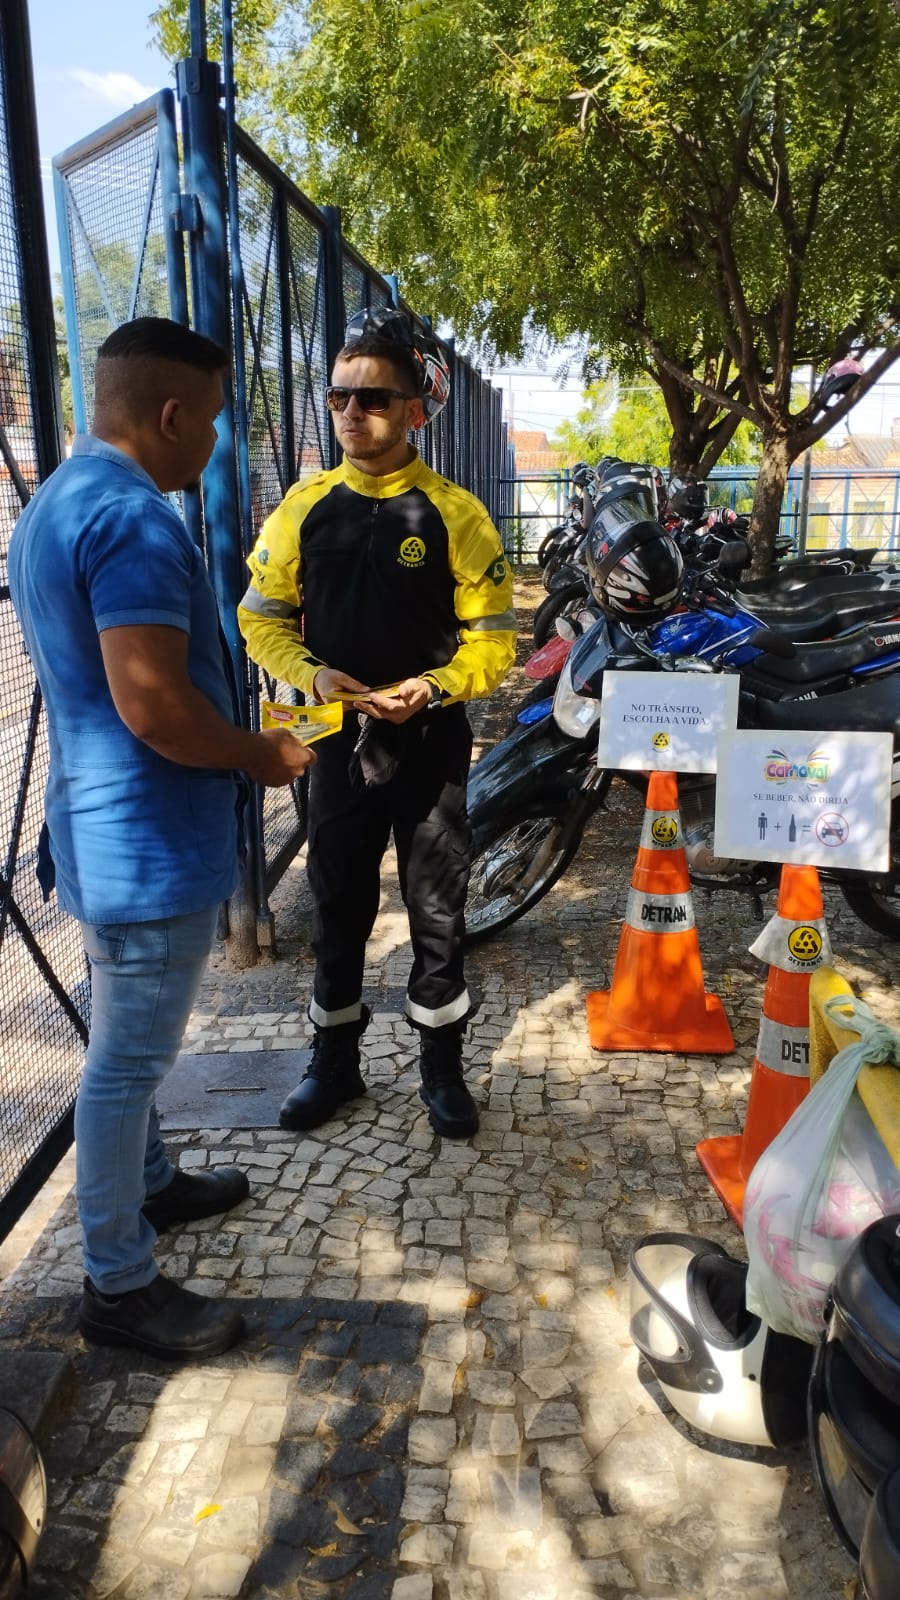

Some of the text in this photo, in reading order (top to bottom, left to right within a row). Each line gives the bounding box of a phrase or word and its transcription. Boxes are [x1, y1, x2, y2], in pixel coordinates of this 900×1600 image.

[882, 633, 900, 645] YAM
[631, 703, 702, 715] NO TRÂNSITO,
[623, 714, 670, 724] ESCOLHA
[671, 716, 680, 725] A
[752, 792, 849, 806] SE BEBER, NÃO DIRIJA
[641, 903, 687, 923] DETRAN
[781, 1039, 810, 1064] DET
